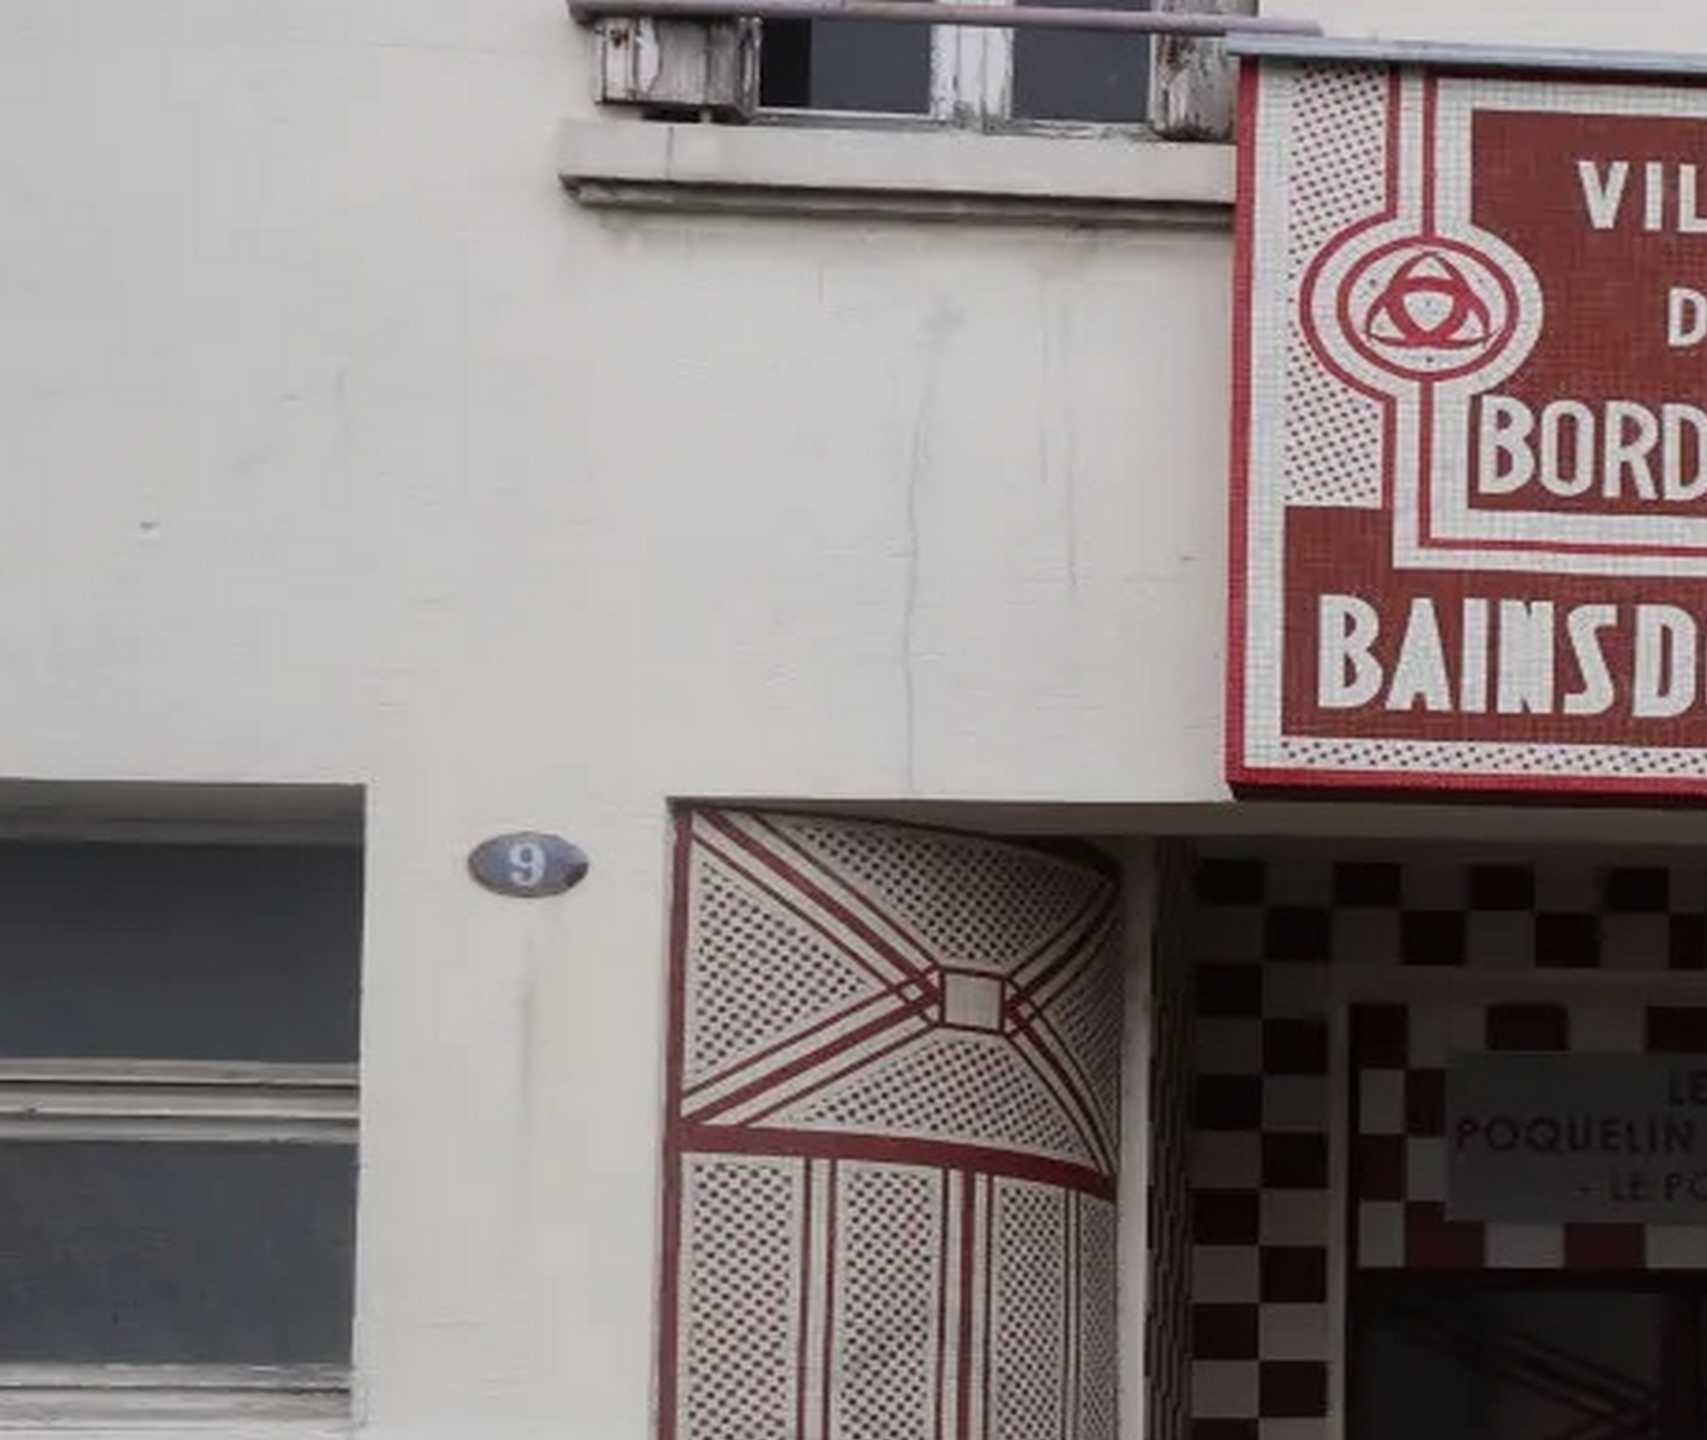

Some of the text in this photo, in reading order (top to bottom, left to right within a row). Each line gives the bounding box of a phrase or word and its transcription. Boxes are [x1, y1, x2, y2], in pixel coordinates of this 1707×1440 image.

[510, 842, 545, 887] 9
[1456, 1117, 1694, 1154] POQUELIN
[1613, 1174, 1647, 1201] LE
